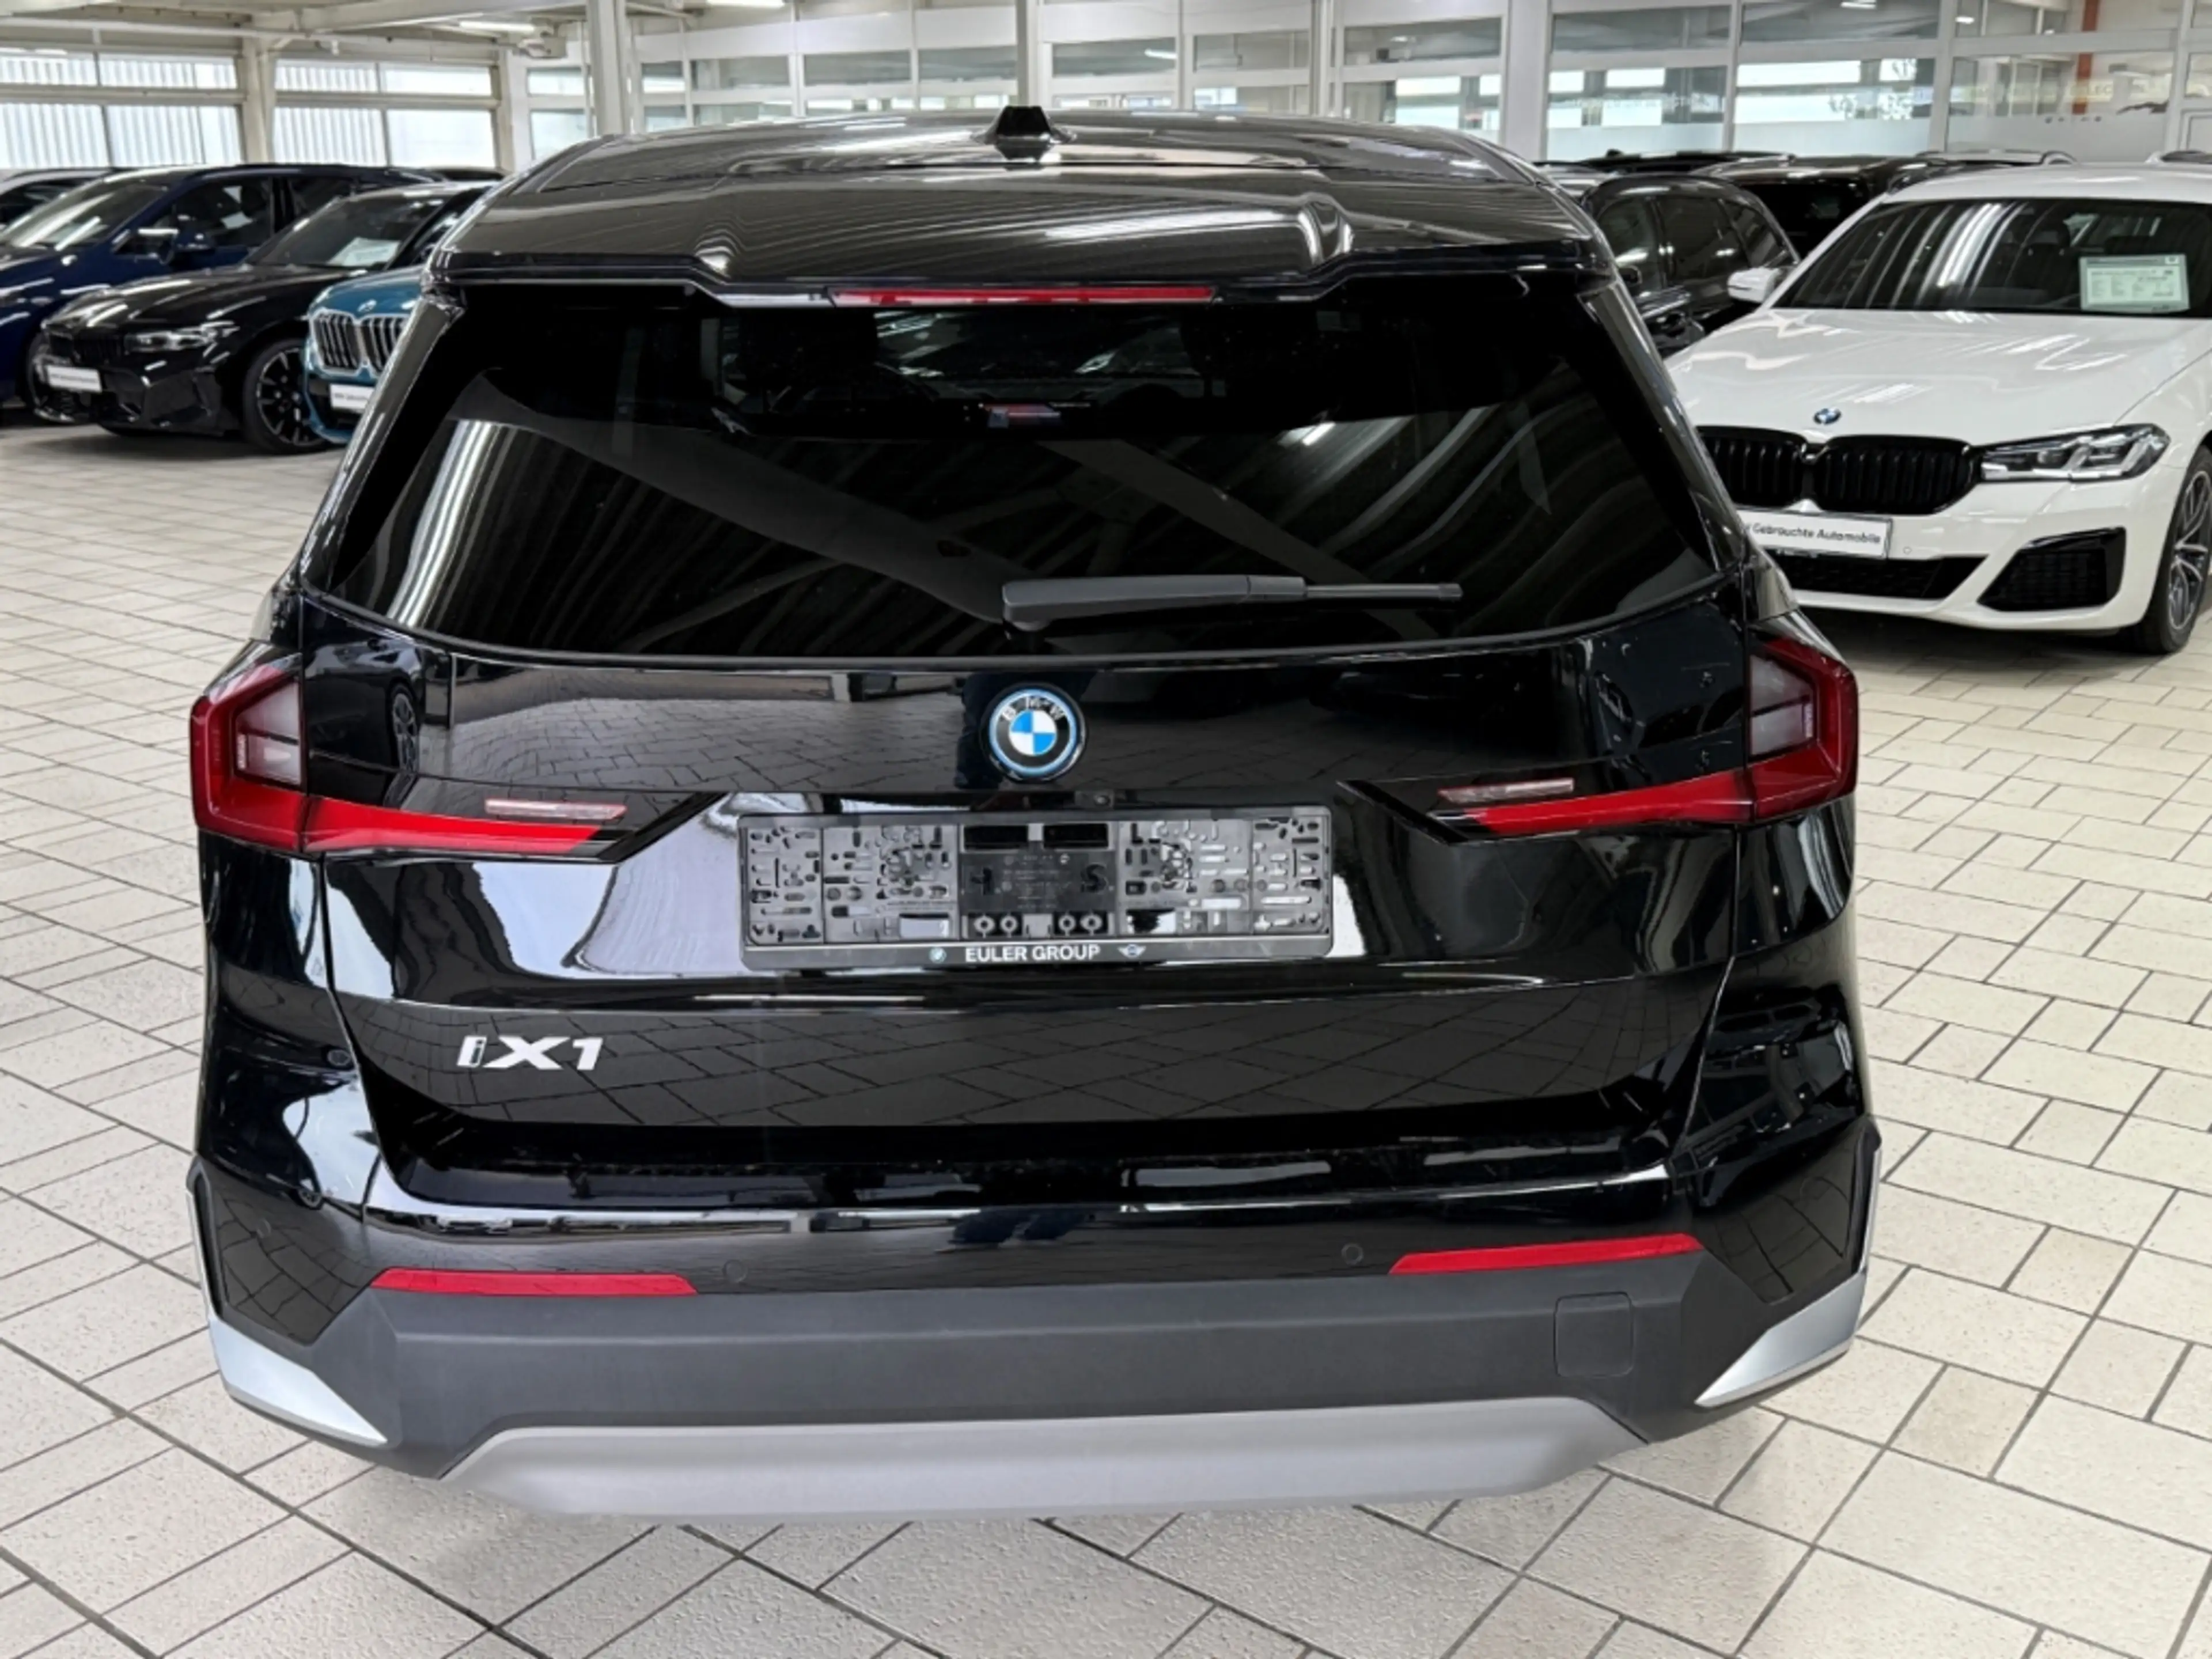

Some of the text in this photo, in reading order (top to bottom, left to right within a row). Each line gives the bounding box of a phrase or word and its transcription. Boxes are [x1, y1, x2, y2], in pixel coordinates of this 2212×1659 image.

[1752, 522, 1814, 538] Gebrauchte
[1817, 529, 1881, 544] Automobile
[1002, 696, 1066, 721] BMW
[965, 944, 1100, 963] EULER GROUP
[456, 1036, 604, 1070] iX1
